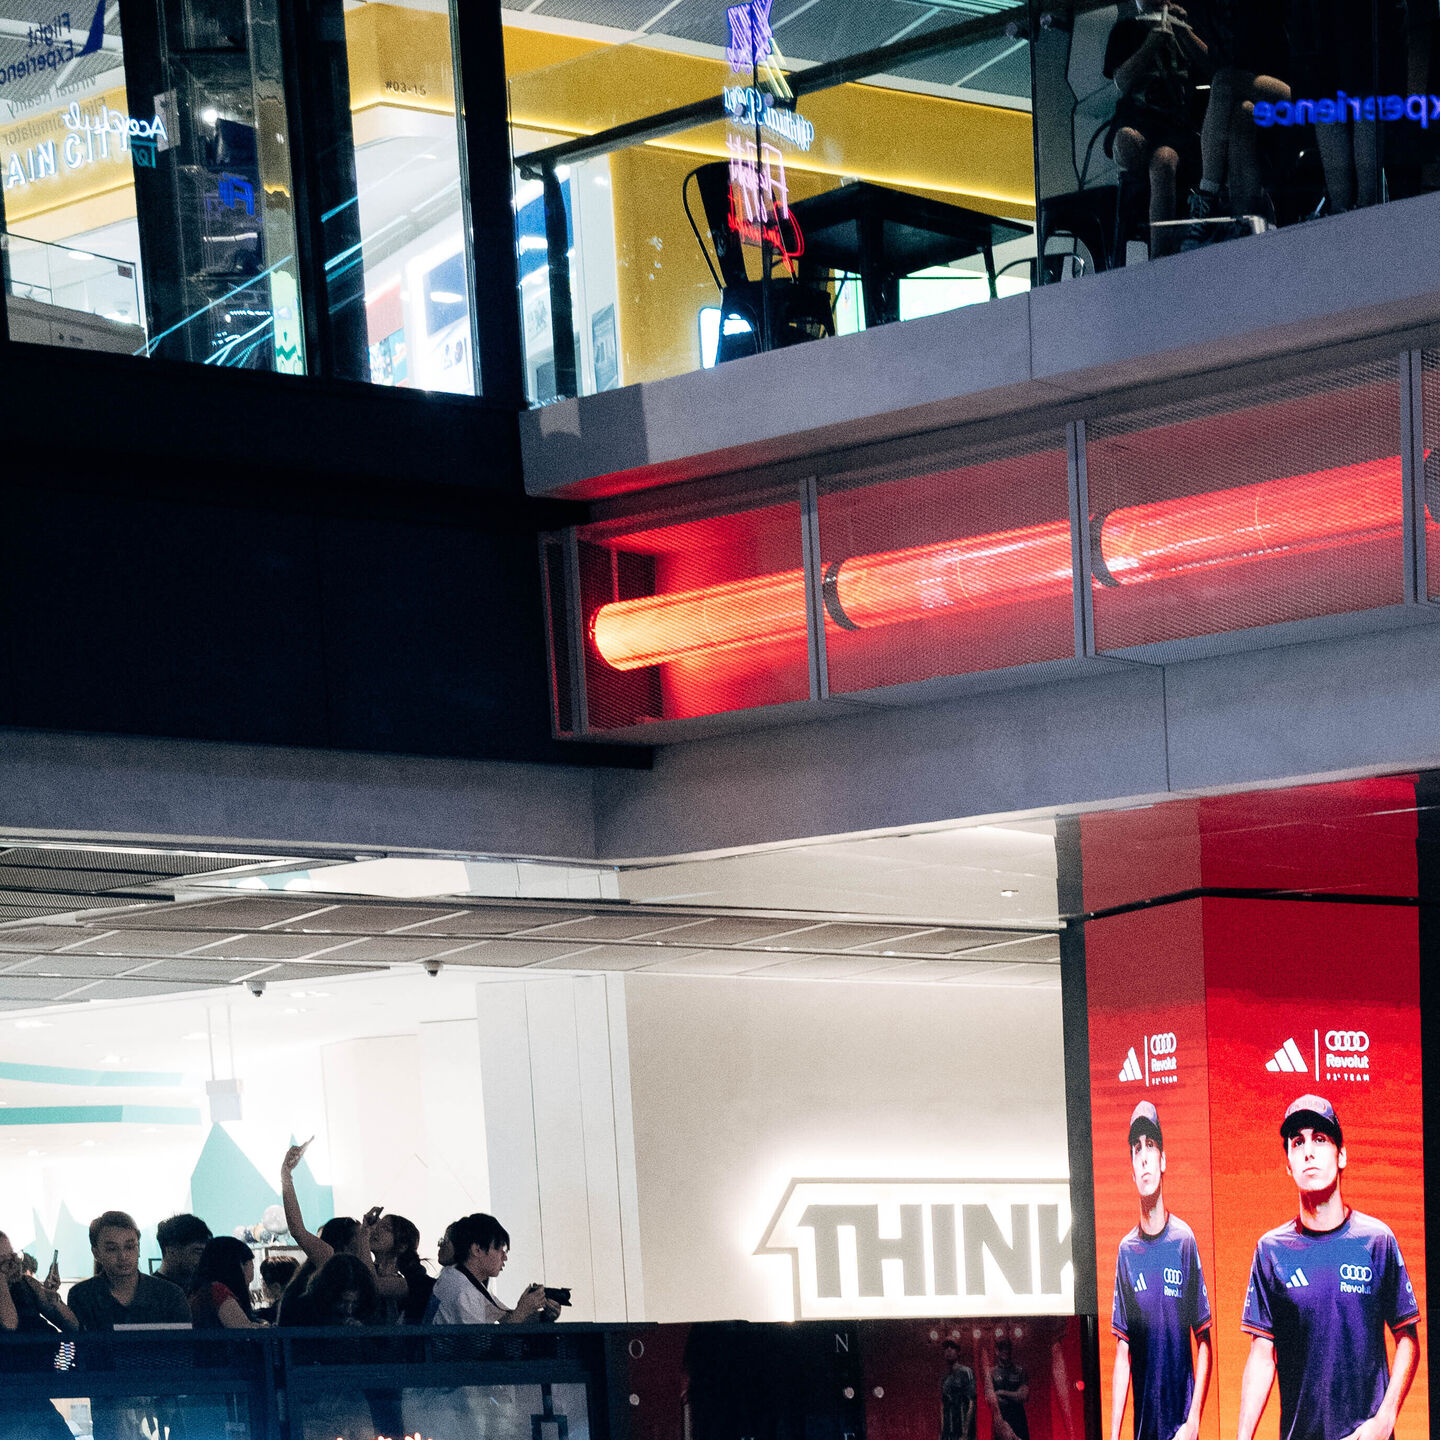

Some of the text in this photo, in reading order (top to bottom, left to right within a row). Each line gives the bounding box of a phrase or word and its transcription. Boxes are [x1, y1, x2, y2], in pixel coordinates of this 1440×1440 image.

[384, 80, 427, 97] #03-15
[1326, 1053, 1370, 1069] Revolut
[797, 1203, 1075, 1298] THINK
